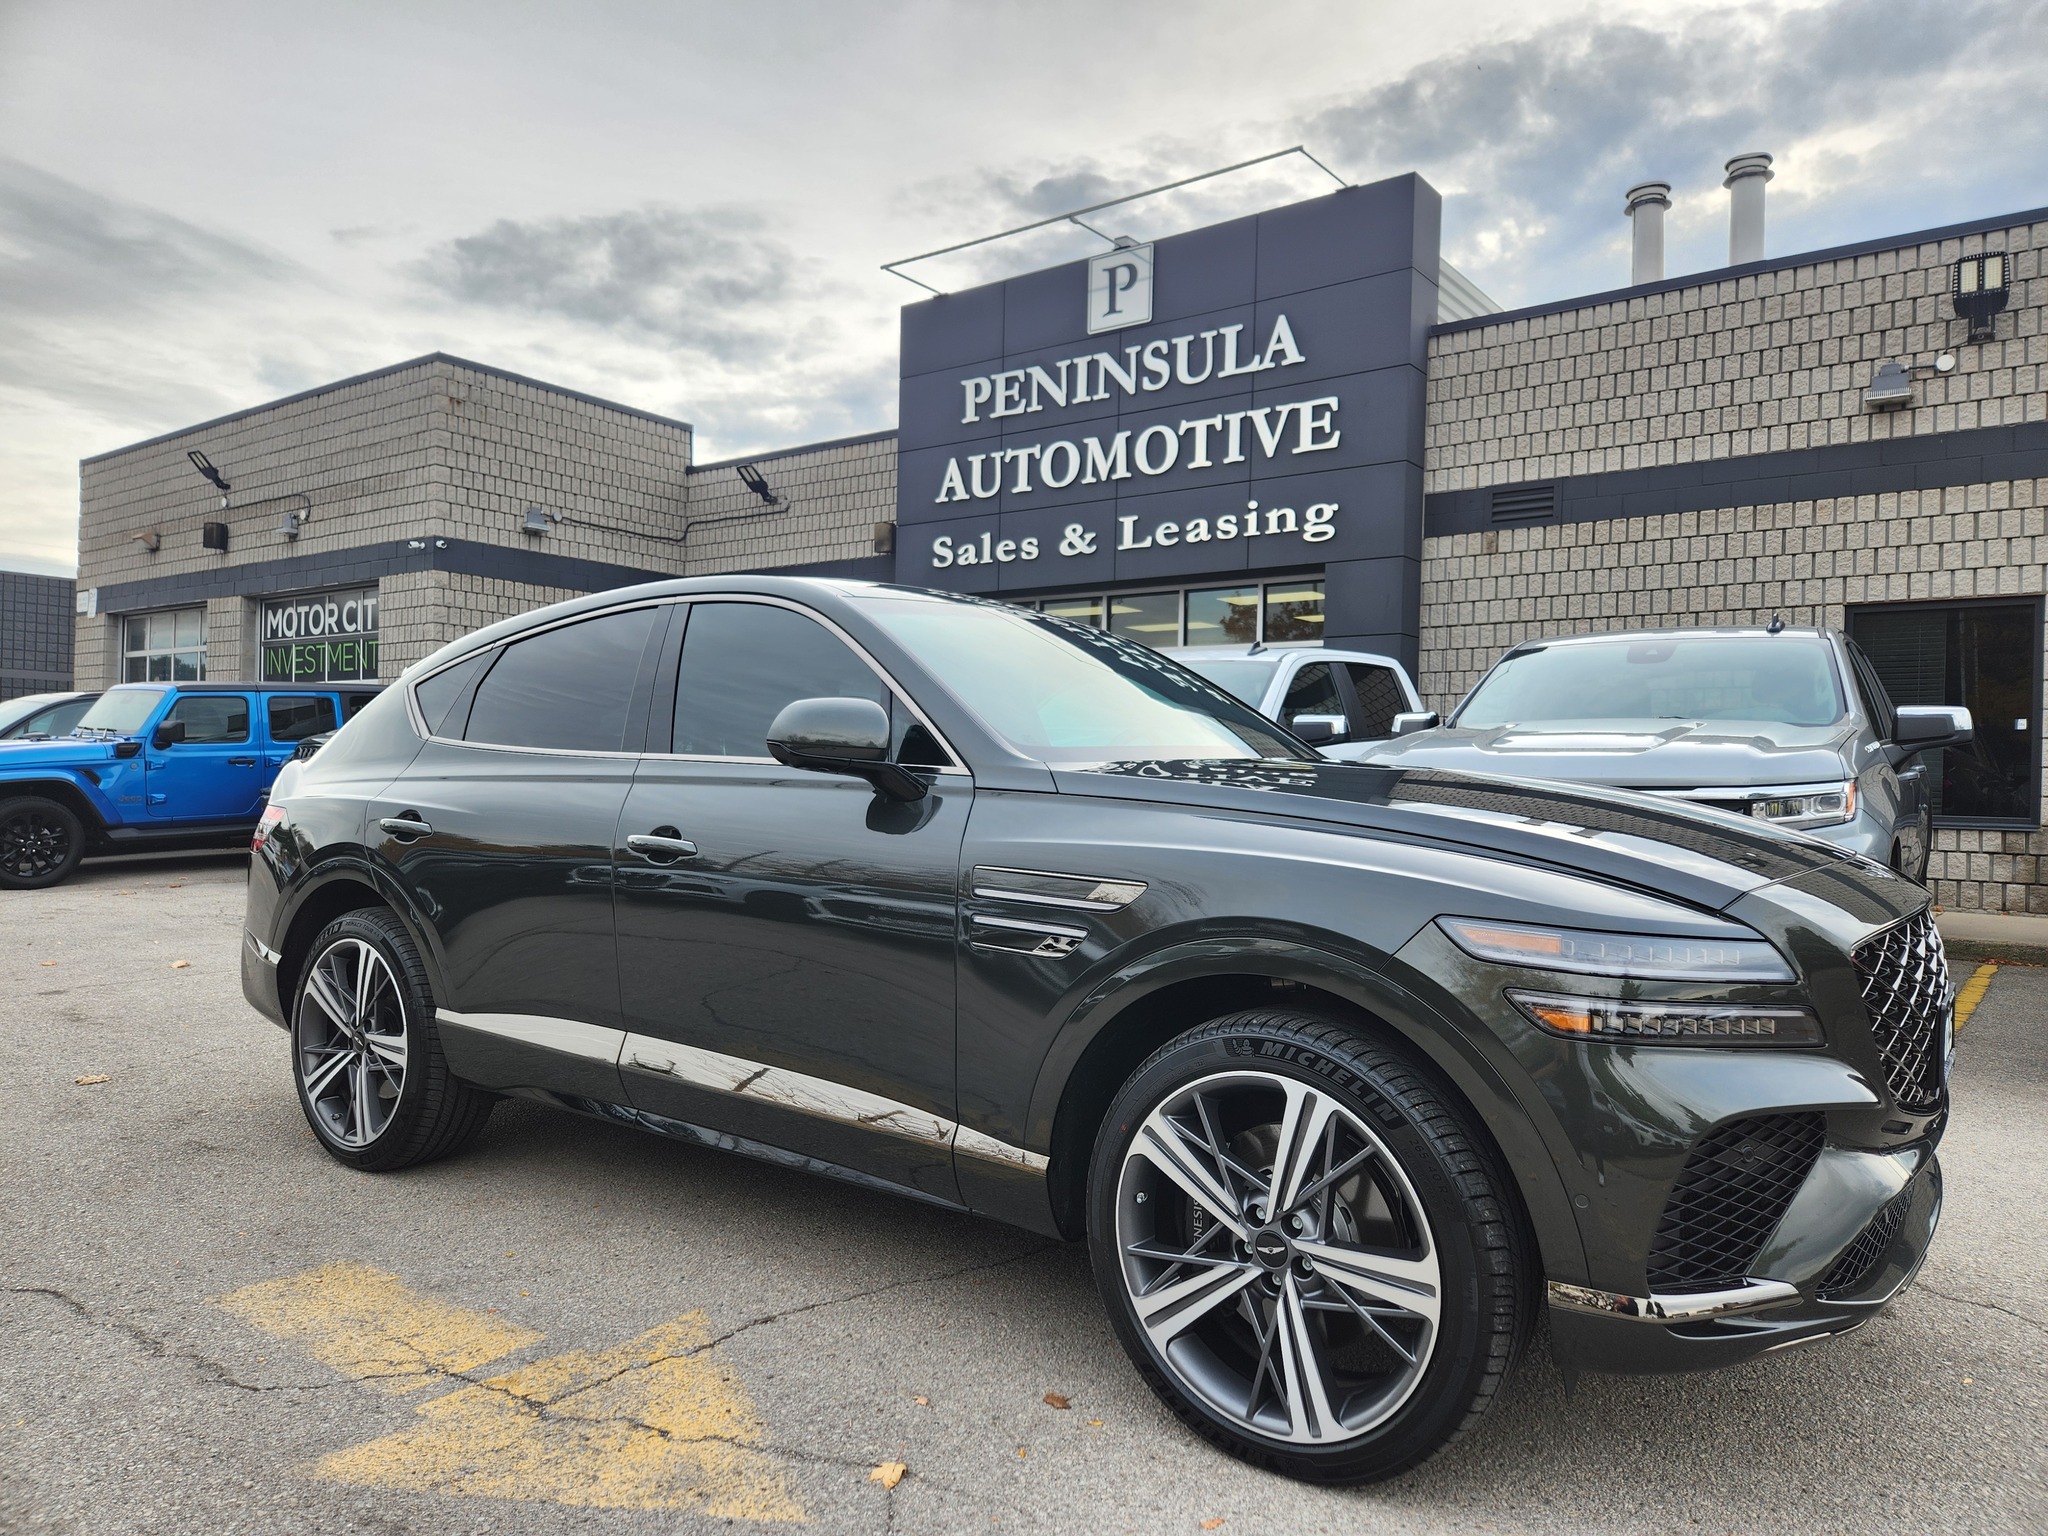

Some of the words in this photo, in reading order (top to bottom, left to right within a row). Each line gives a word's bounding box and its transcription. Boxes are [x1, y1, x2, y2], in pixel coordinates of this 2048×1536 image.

[1103, 263, 1138, 318] P
[960, 313, 1306, 425] PENINSULA
[935, 396, 1341, 504] AUTOMOTIVE
[932, 532, 1040, 569] Sales
[1058, 523, 1098, 557] &
[1117, 500, 1339, 550] Leasing
[266, 602, 340, 639] MOTOR
[342, 598, 380, 633] CIT
[266, 640, 379, 676] INVESTMENT
[1259, 1040, 1400, 1122] MICHELIN
